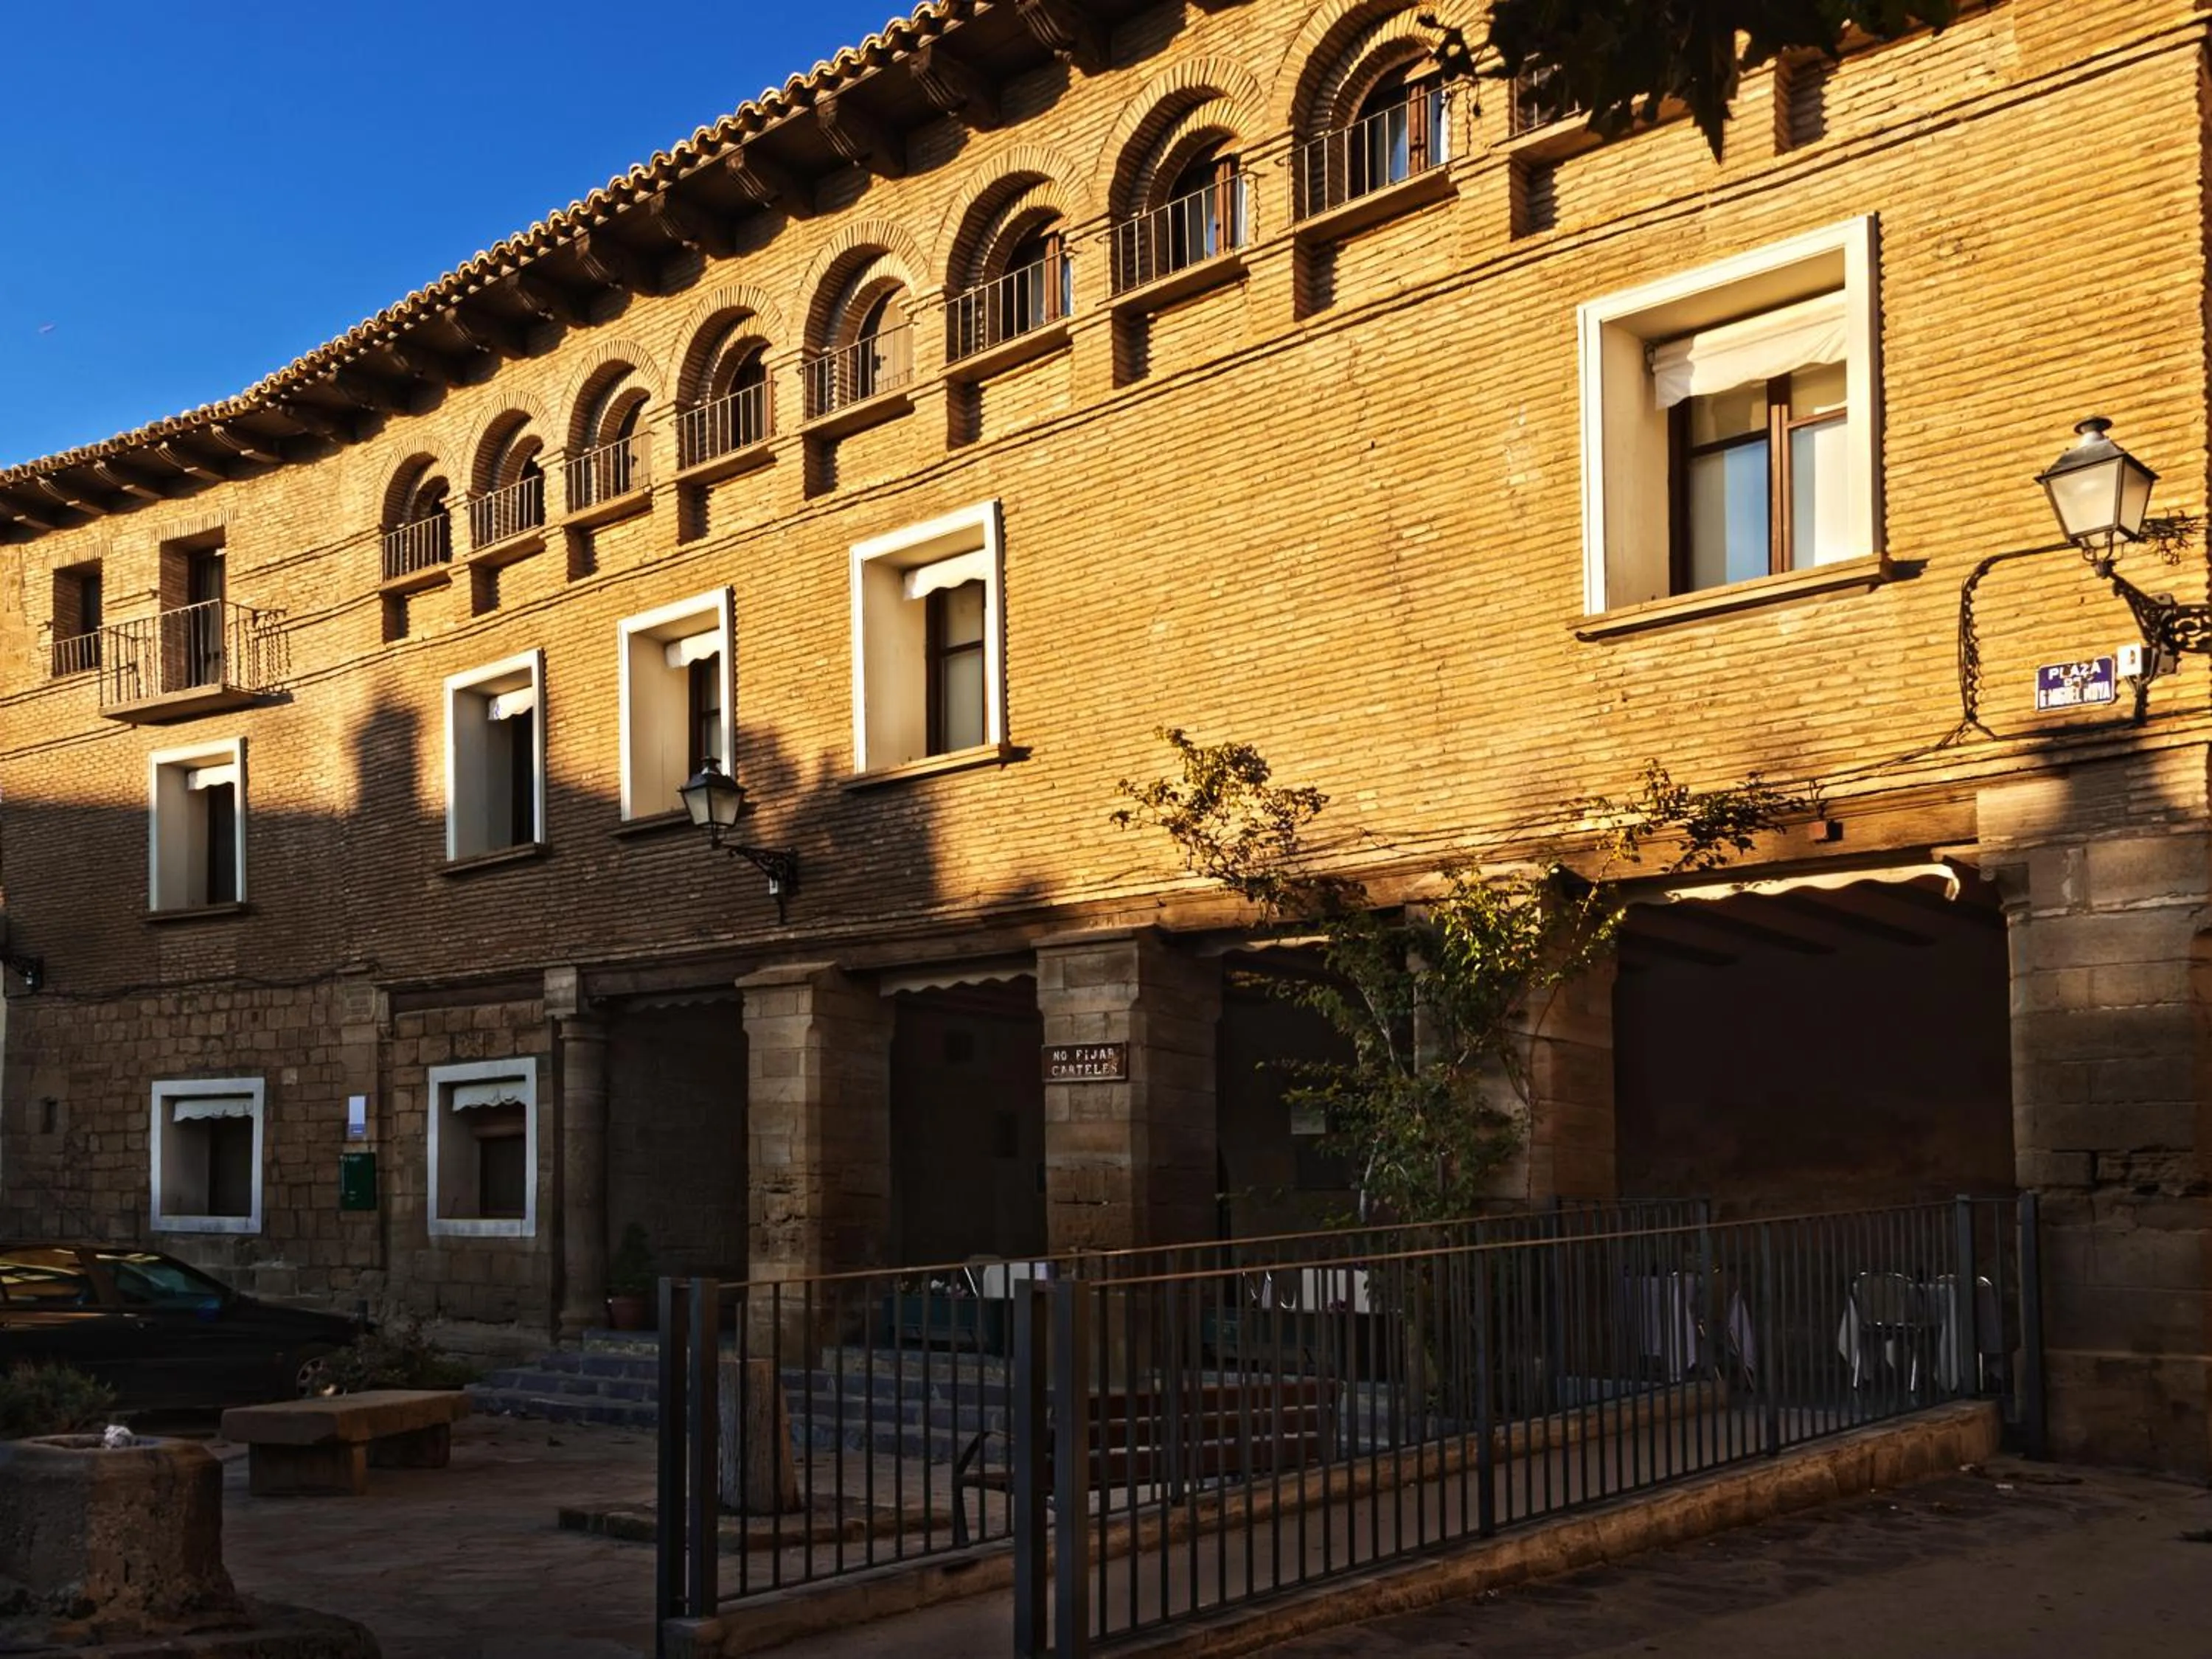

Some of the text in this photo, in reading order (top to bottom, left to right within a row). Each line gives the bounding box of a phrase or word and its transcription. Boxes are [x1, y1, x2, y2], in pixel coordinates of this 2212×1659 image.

[2048, 661, 2101, 680] PLAZA
[2083, 681, 2110, 703] MOYA
[1053, 1048, 1114, 1062] NO FIJAR
[1051, 1062, 1118, 1077] CARTELES
